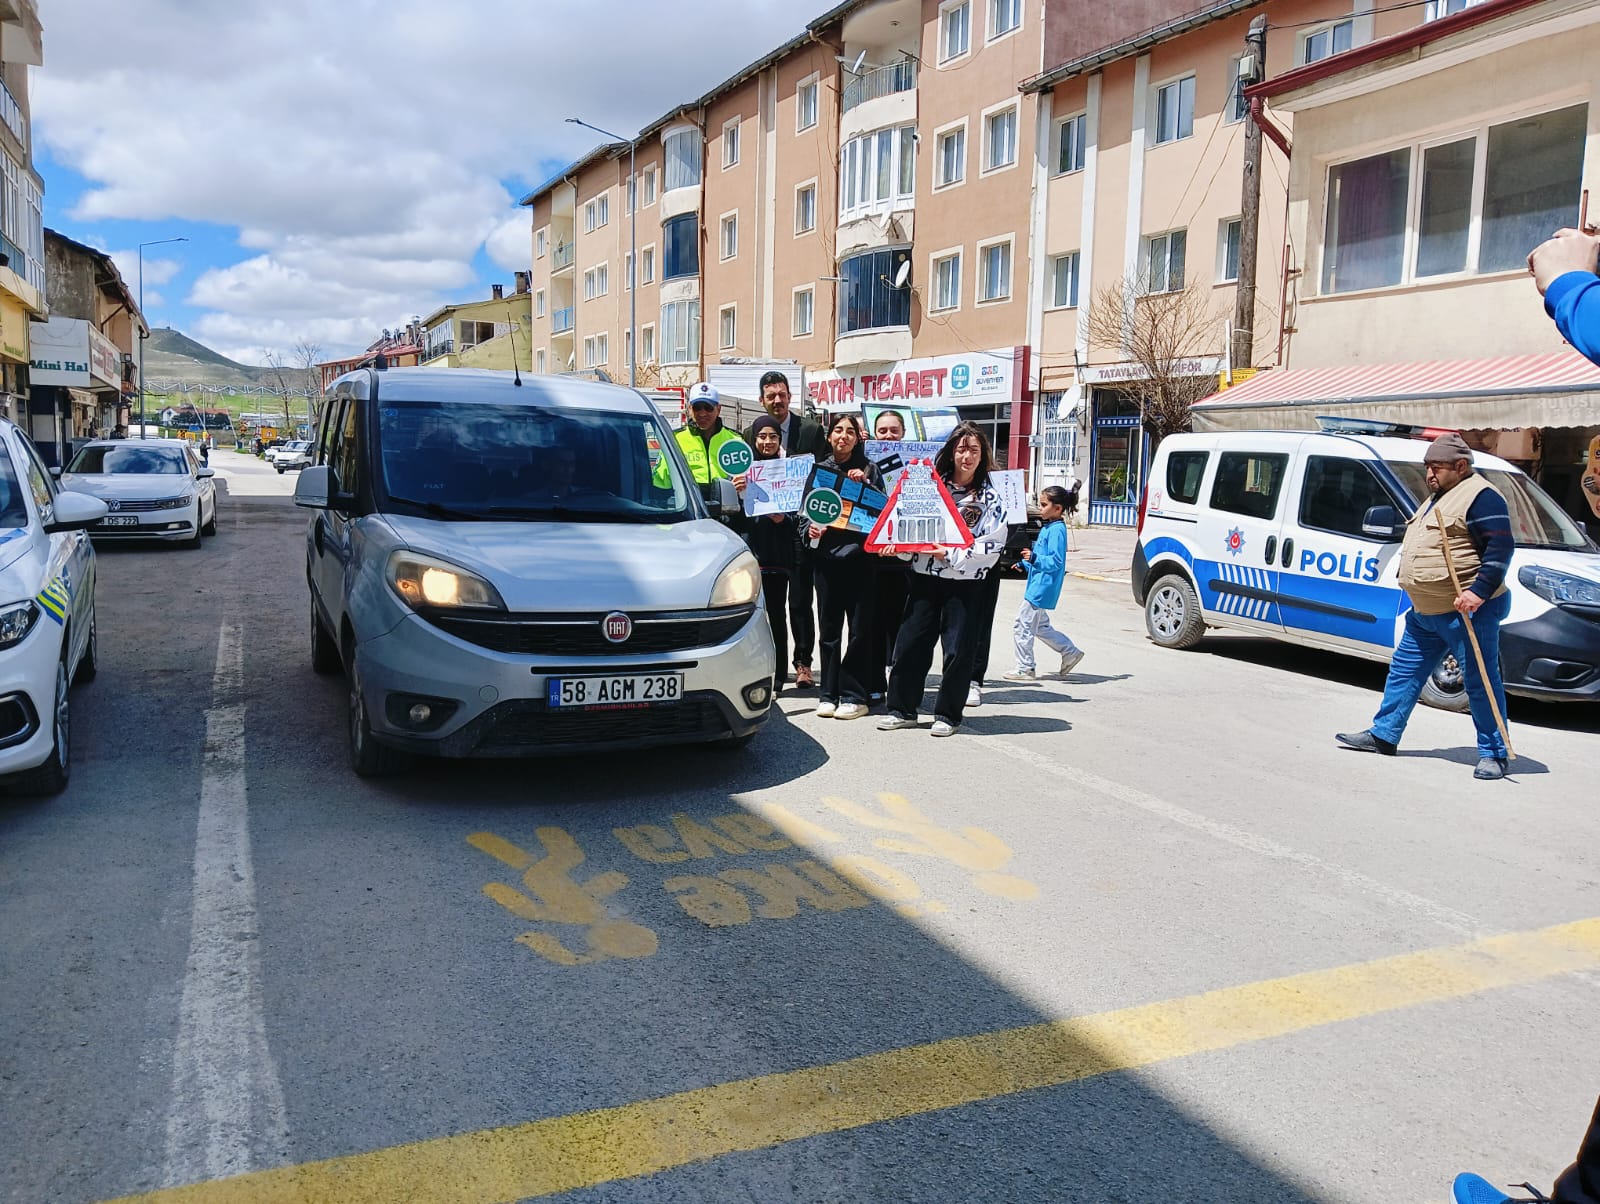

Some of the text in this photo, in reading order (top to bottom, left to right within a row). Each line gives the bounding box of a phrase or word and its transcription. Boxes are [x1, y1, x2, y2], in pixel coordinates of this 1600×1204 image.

[31, 359, 89, 373] Mini Hal
[721, 450, 749, 466] GEÇ
[809, 498, 839, 518] GEÇ
[1299, 549, 1380, 582] POLİS
[609, 621, 626, 635] FIAT
[562, 681, 586, 703] 58
[597, 678, 636, 701] AGM
[642, 676, 678, 699] 238
